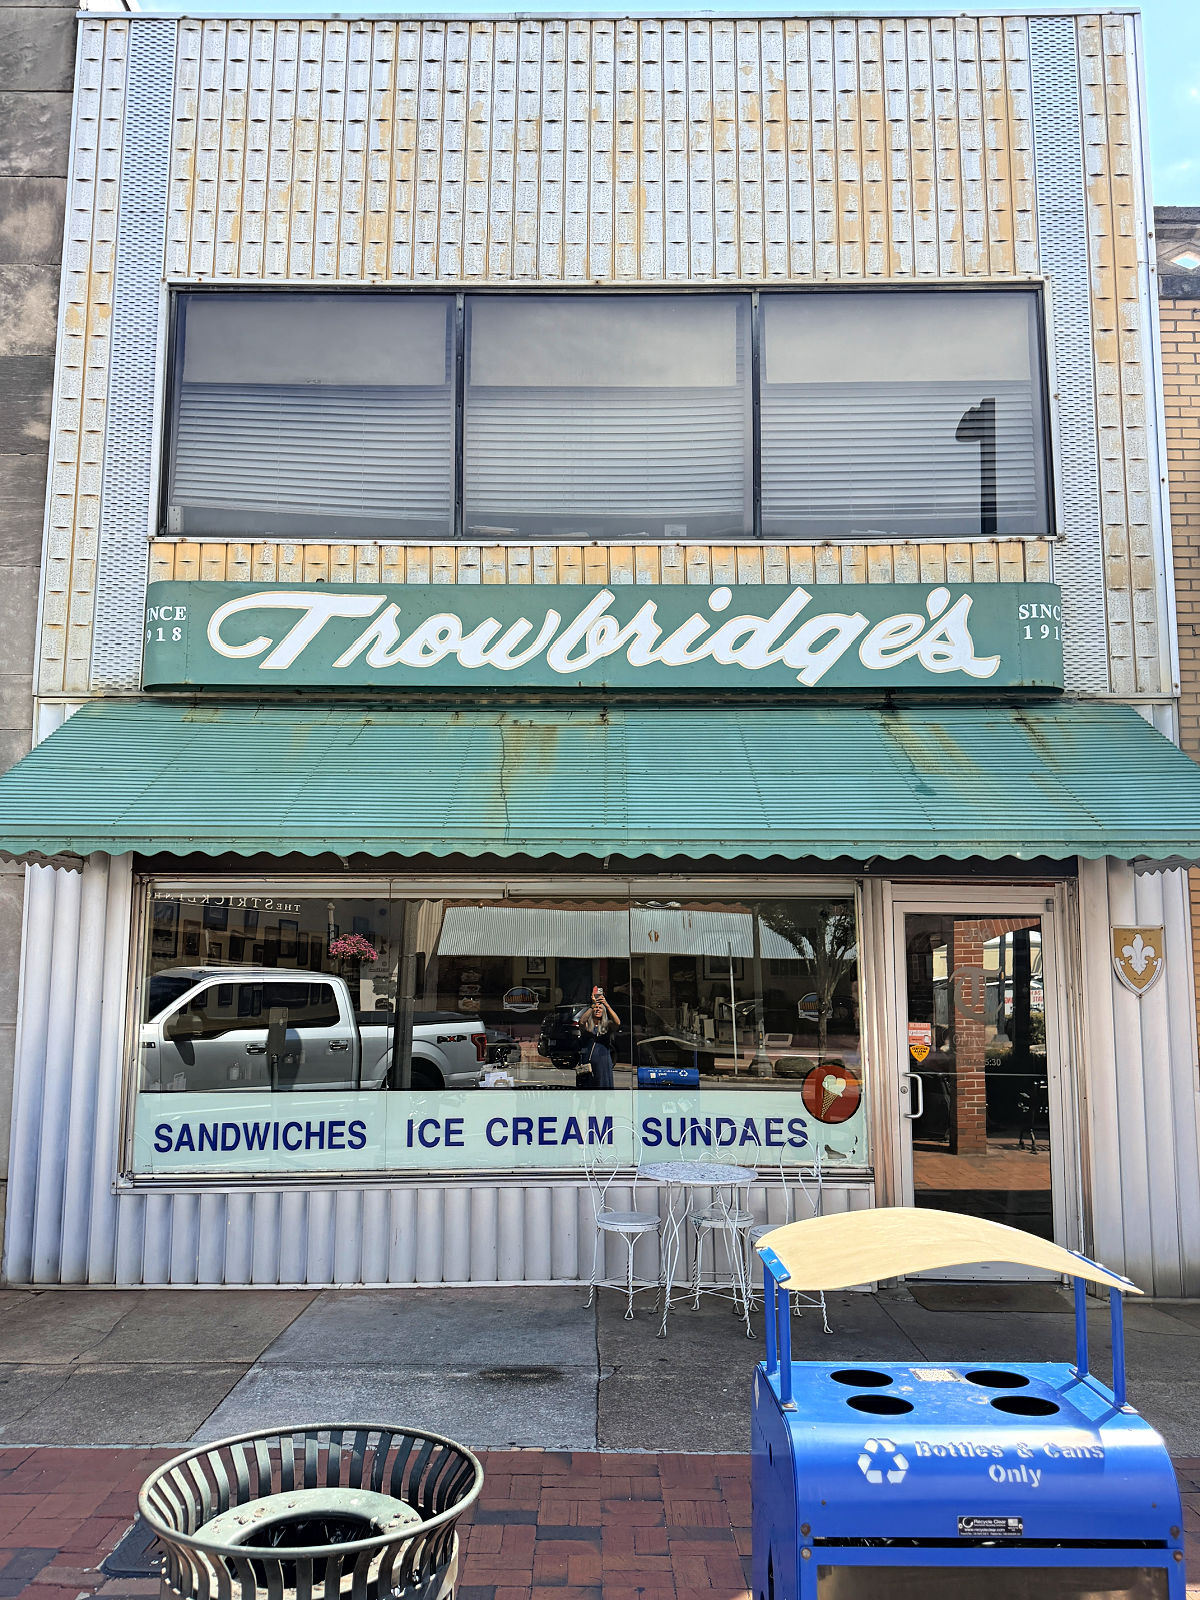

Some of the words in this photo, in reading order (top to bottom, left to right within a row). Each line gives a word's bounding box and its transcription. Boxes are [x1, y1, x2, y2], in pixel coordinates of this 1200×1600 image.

[207, 586, 1001, 687] Trowbridge's
[153, 1120, 367, 1153] SANDWICHES
[406, 1118, 465, 1148] ICE
[485, 1115, 614, 1148] CREAM
[641, 1116, 809, 1148] SUNDAES
[914, 1441, 1005, 1458] Bottles
[1016, 1441, 1035, 1459] &
[1042, 1442, 1105, 1459] Cans
[988, 1463, 1042, 1488] Only
